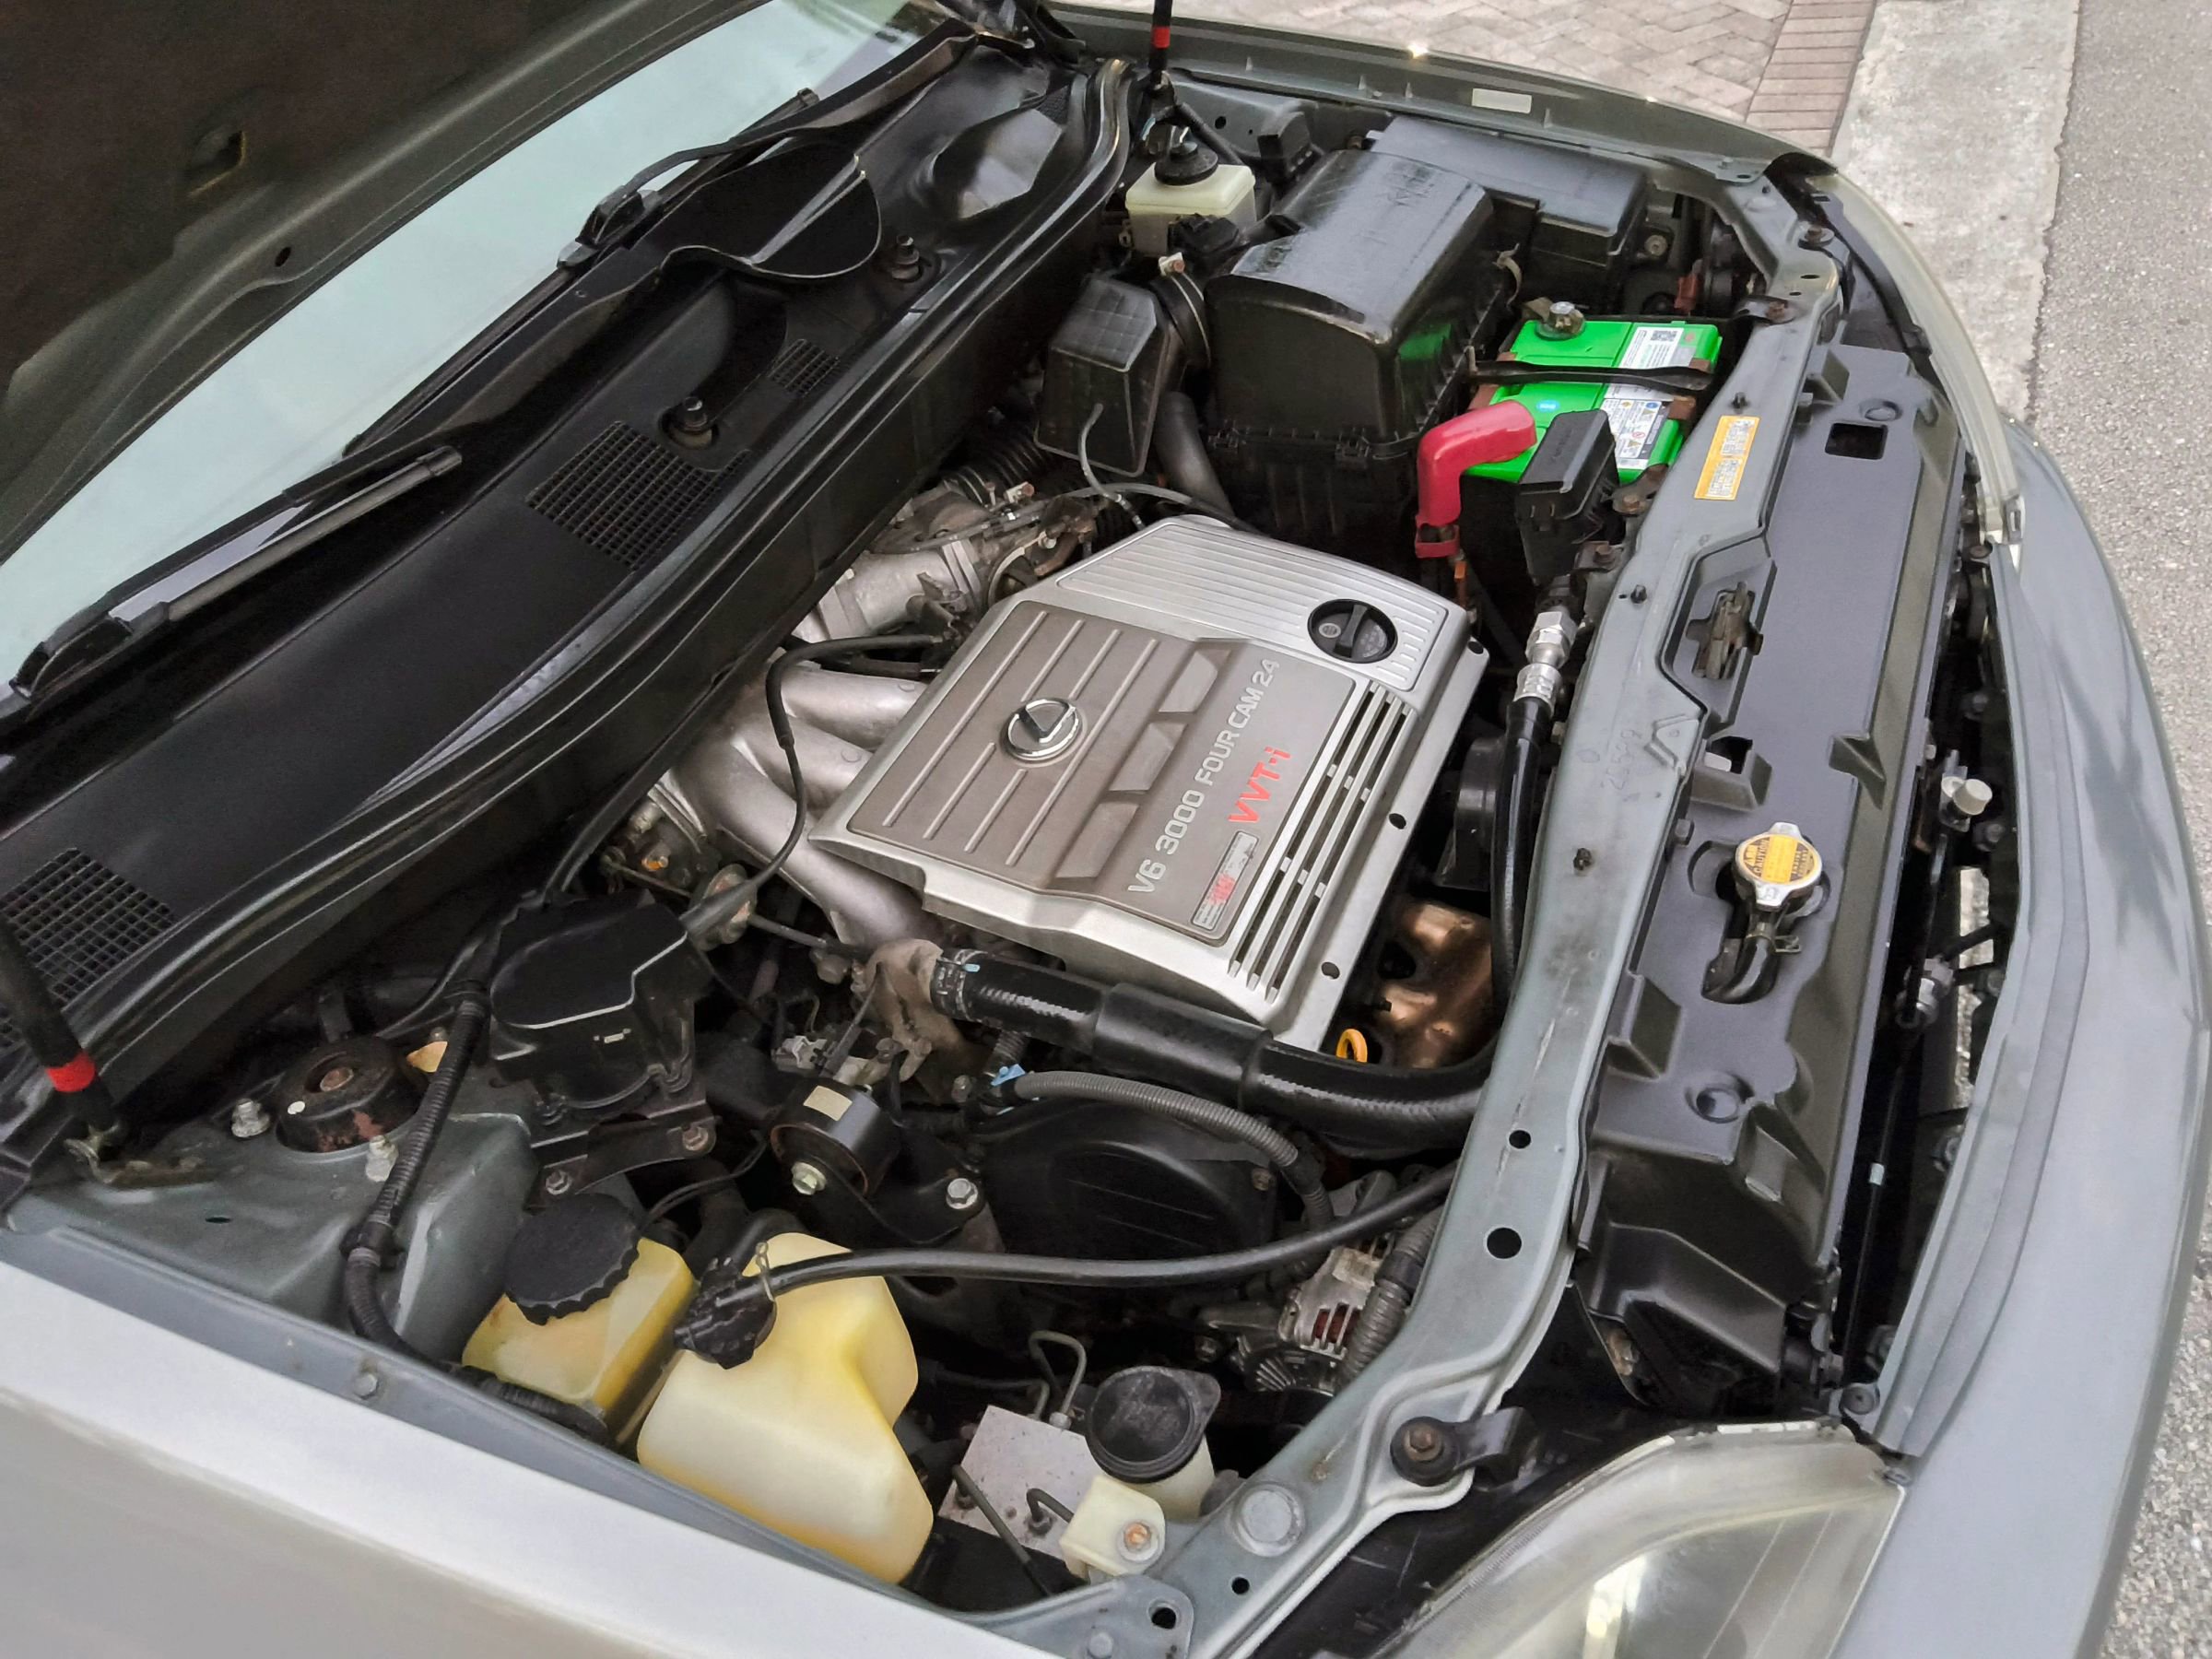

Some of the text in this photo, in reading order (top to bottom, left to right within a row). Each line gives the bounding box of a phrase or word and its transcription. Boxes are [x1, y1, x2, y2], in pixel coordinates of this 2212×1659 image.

[1128, 859, 1166, 893] V6
[1155, 789, 1205, 855] 3000
[1194, 729, 1241, 786] FOUR
[1228, 688, 1265, 729] CAM
[1252, 658, 1280, 687] 24
[1228, 746, 1292, 823] VVT-i
[1753, 839, 1770, 875] CAUTION
